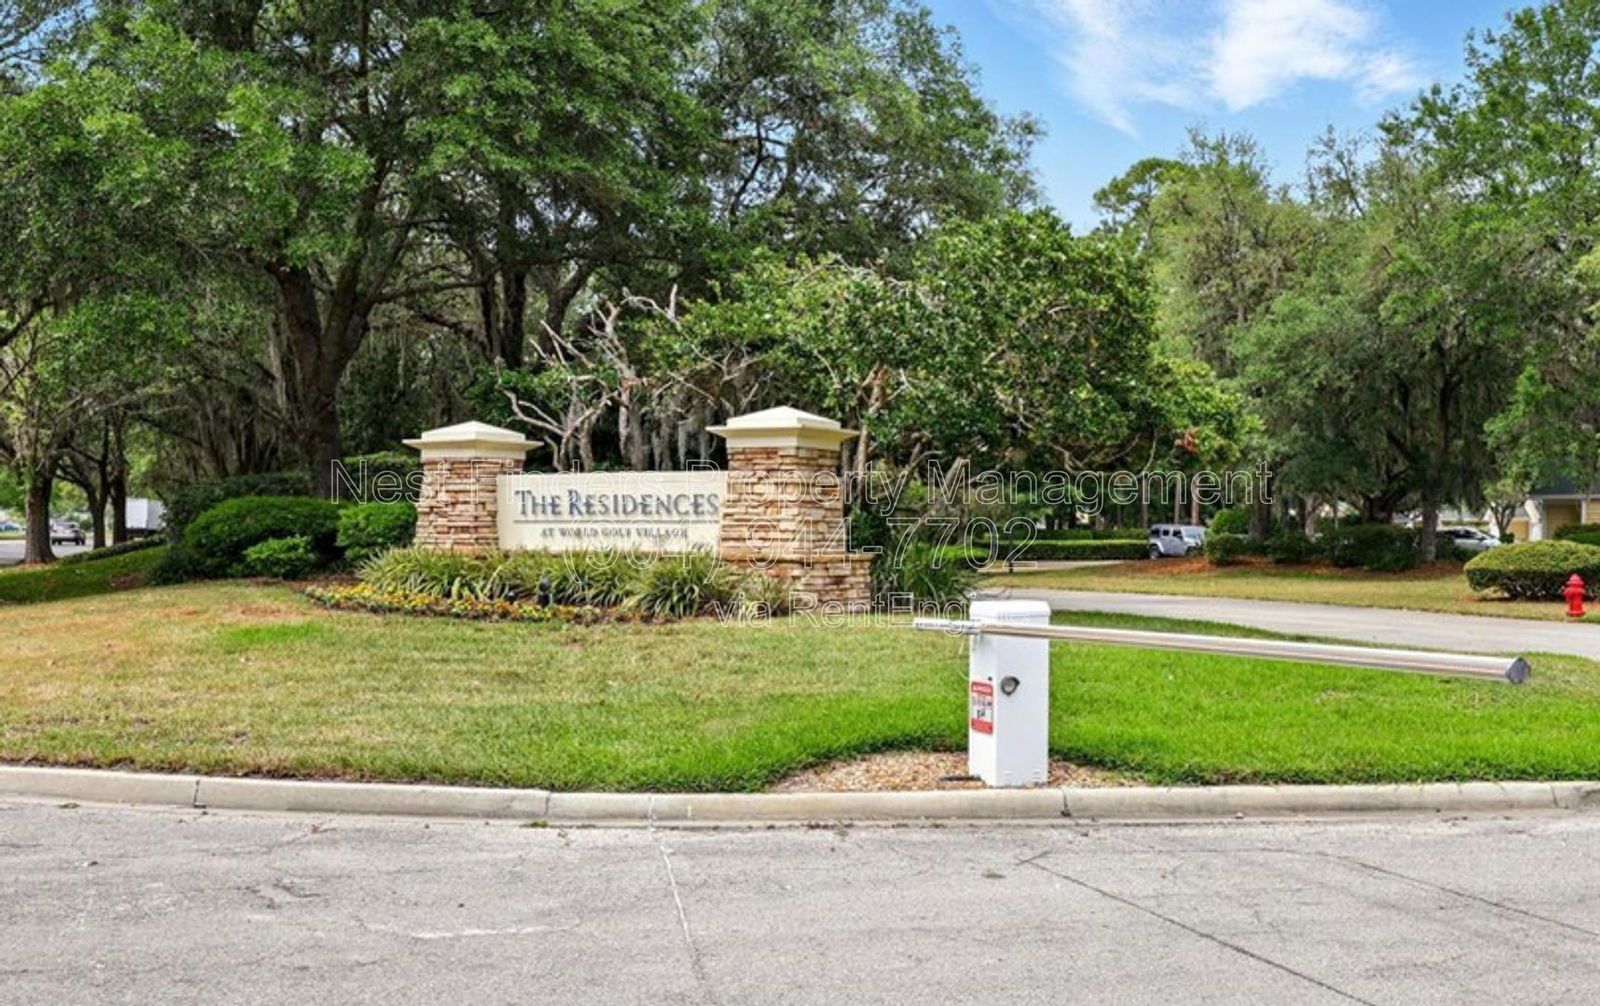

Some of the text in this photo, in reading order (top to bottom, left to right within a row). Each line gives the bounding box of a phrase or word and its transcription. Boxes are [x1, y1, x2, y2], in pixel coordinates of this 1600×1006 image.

[514, 489, 720, 517] THE RESIDENCES
[541, 527, 555, 539] AT
